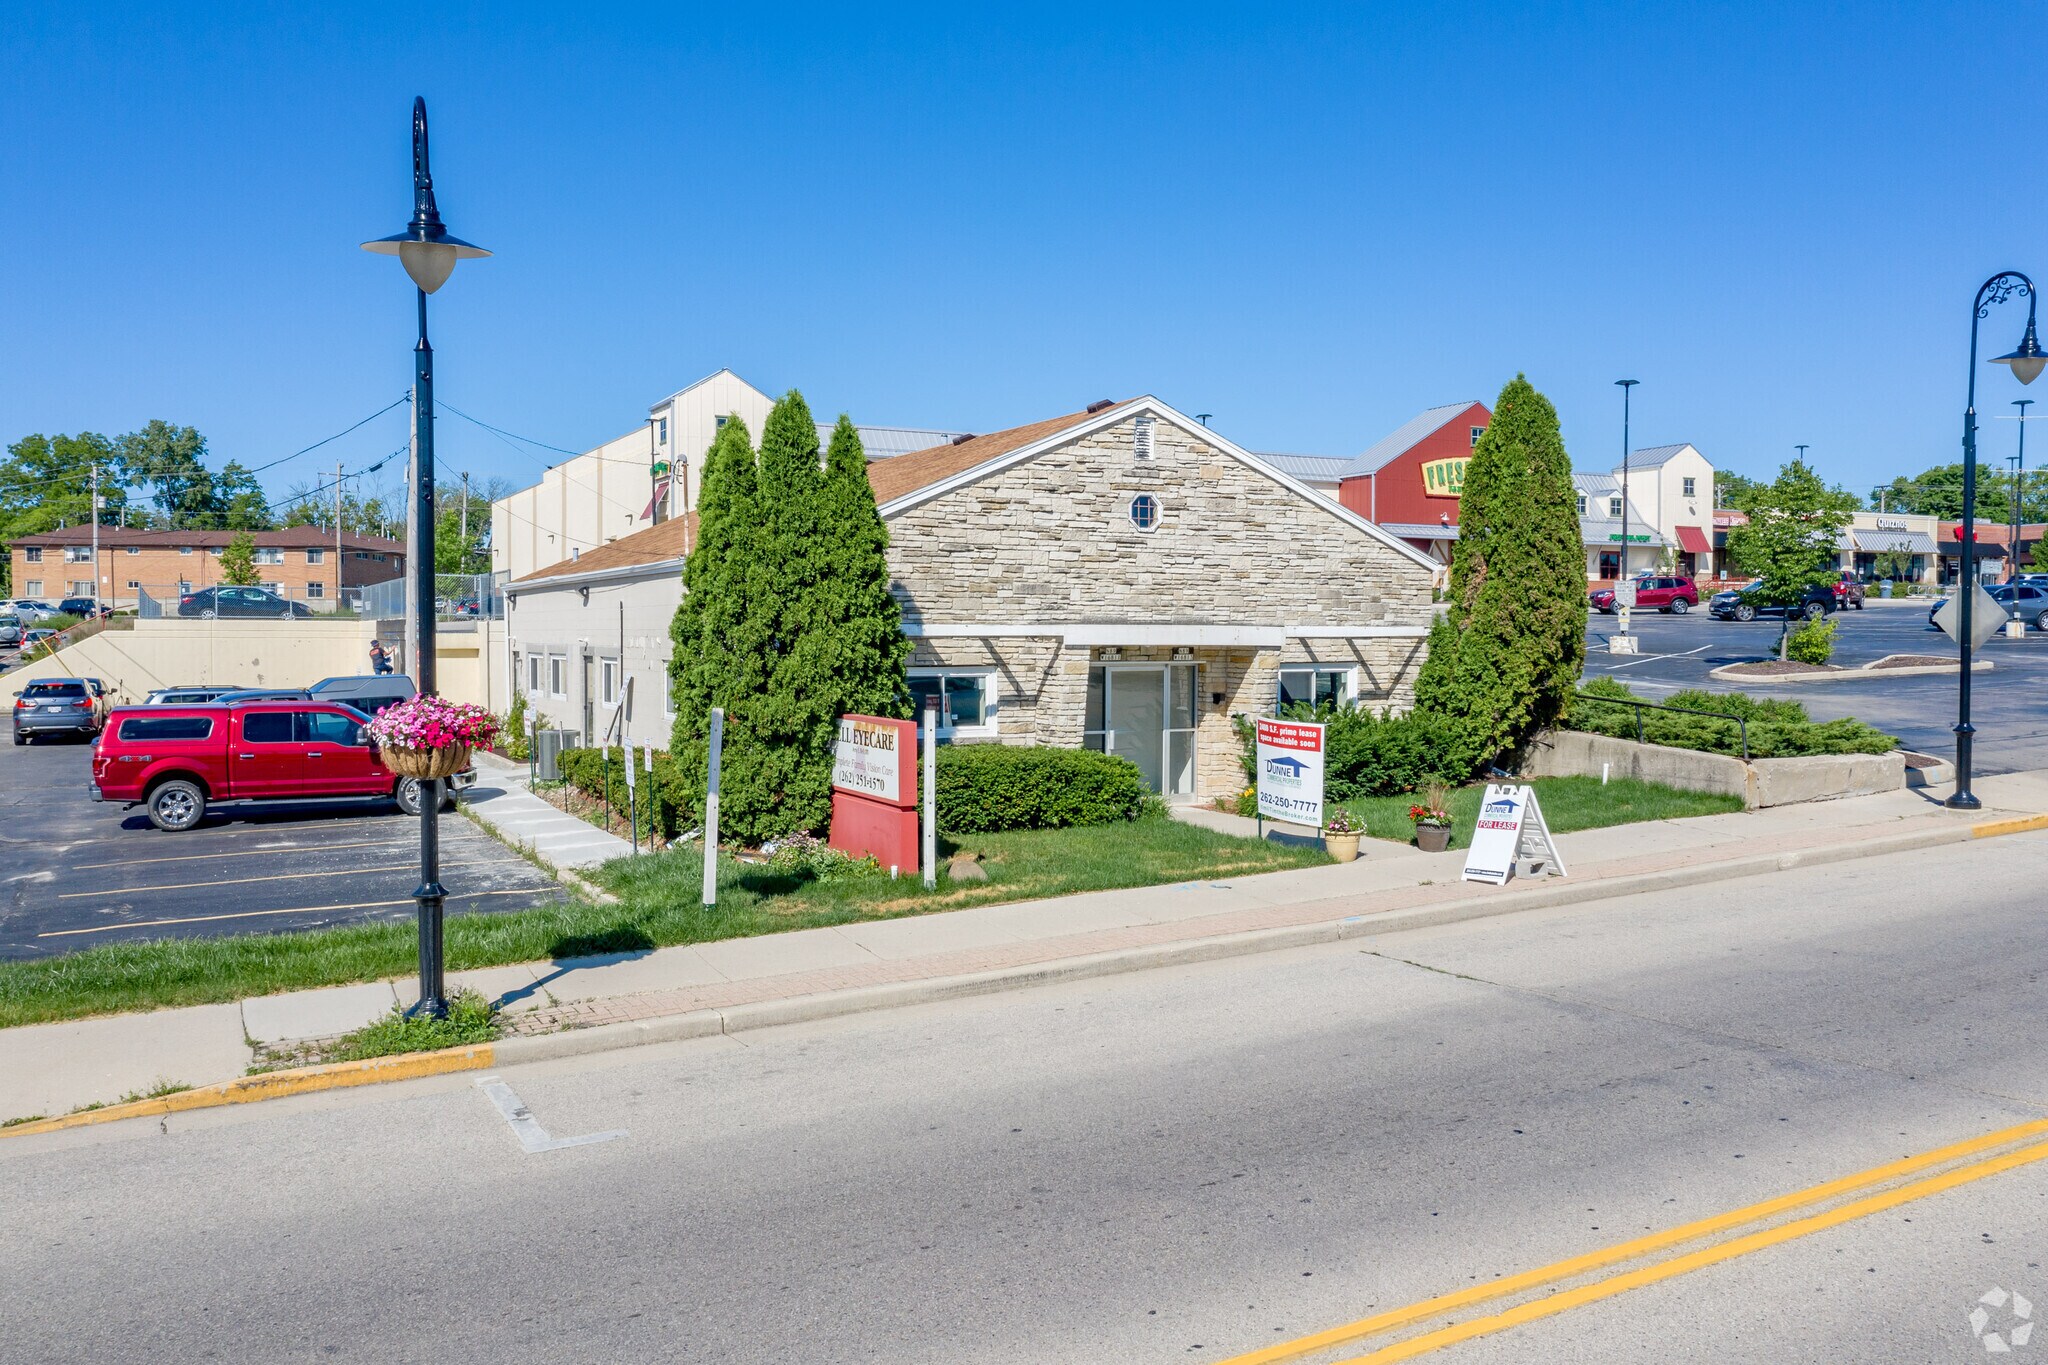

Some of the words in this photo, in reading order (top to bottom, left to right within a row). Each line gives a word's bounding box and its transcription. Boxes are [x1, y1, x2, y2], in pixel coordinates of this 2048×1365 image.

[1426, 461, 1471, 490] FRES
[853, 728, 895, 751] EYECARE
[1260, 734, 1272, 742] space
[1273, 737, 1298, 746] available
[1300, 740, 1316, 748] soon
[1280, 727, 1297, 736] prime
[1298, 729, 1317, 738] lease
[1260, 791, 1318, 813] 262-250-7777
[1479, 820, 1492, 829] FOR
[1494, 821, 1516, 830] LEASE
